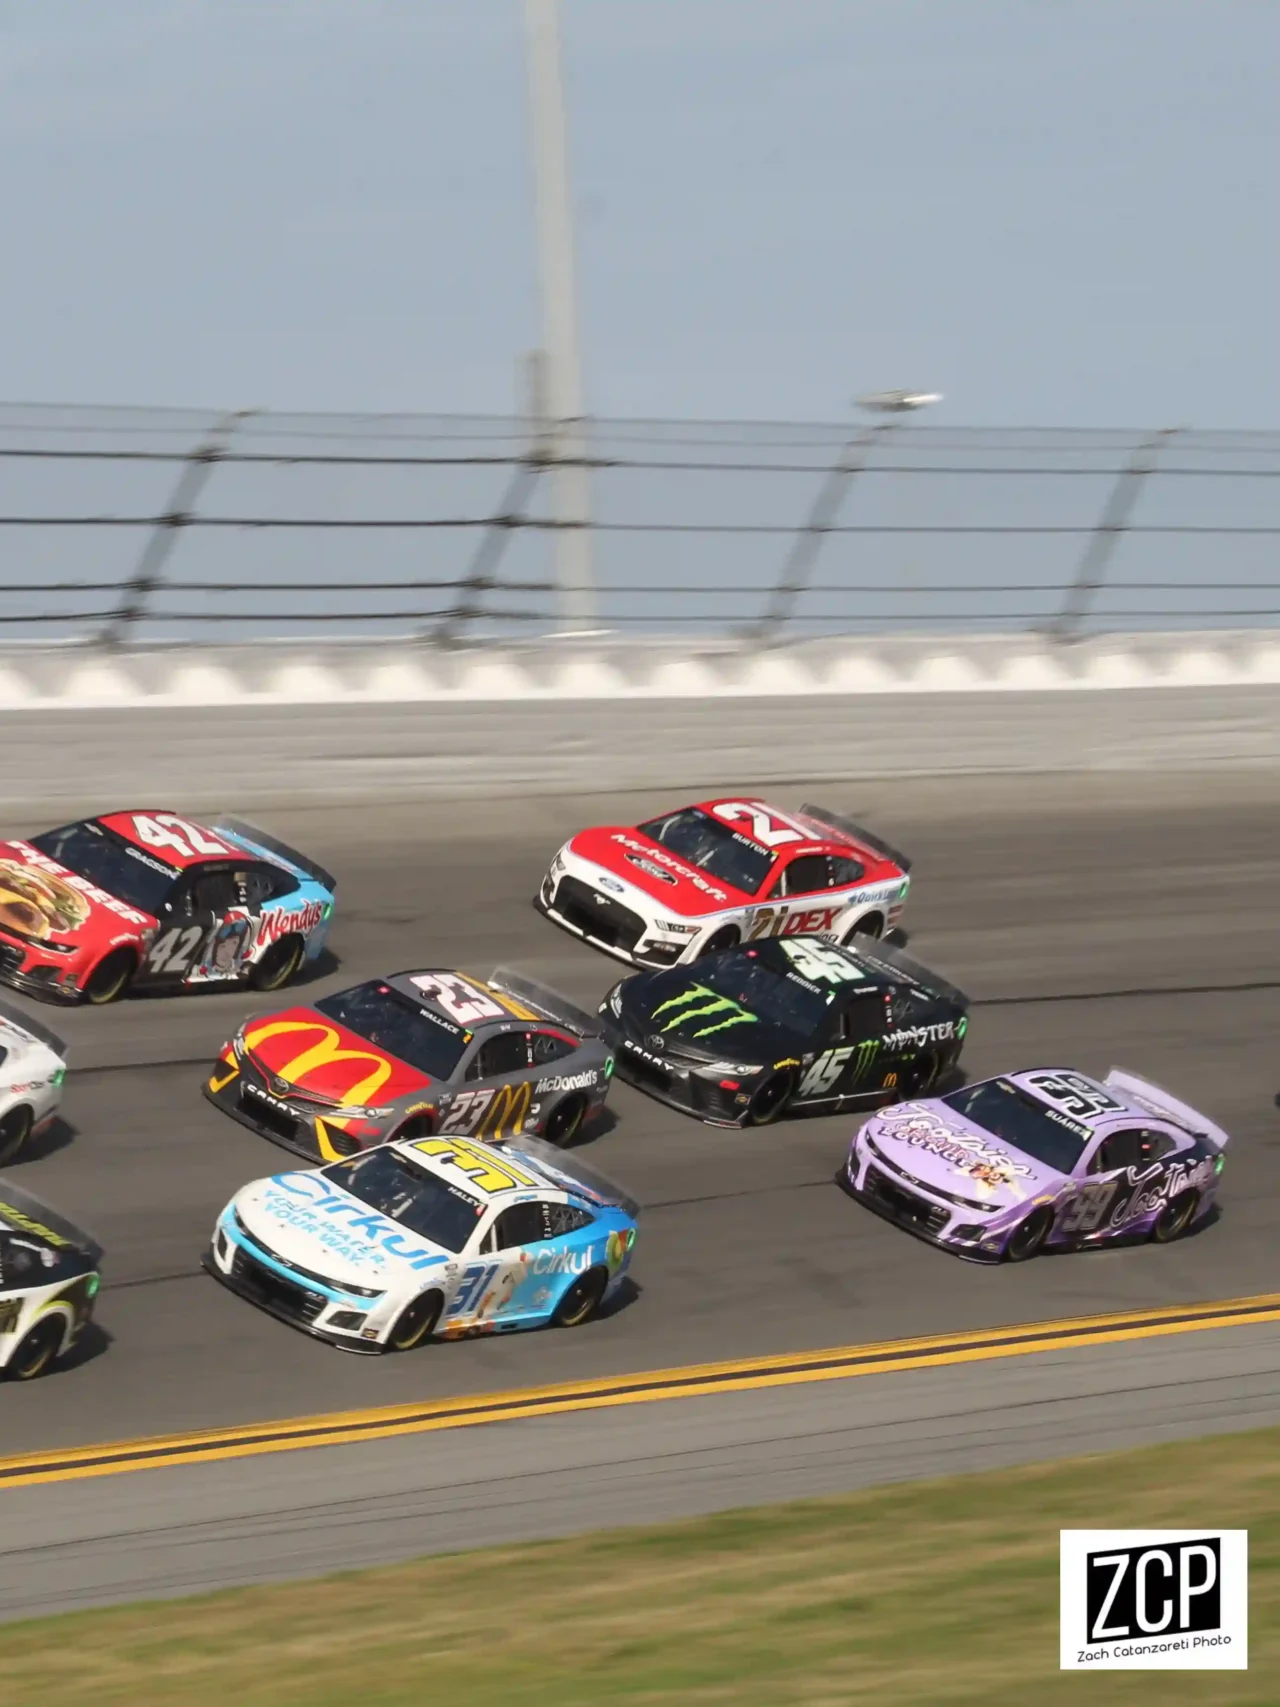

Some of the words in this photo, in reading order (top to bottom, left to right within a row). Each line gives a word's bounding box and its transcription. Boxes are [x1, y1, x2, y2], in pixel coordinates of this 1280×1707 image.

[131, 815, 229, 857] 42
[713, 802, 822, 847] 21
[731, 832, 769, 856] BURTON
[6, 840, 70, 875] THE
[62, 875, 148, 925] BEEF
[610, 833, 727, 902] Motorcraft
[782, 907, 843, 935] DEX
[148, 926, 203, 973] 42
[409, 973, 505, 1025] 23
[785, 971, 822, 995] REDDICK
[419, 1008, 460, 1035] WALLACE
[882, 1021, 955, 1050] MONSTER
[535, 1070, 598, 1095] McDonald's
[798, 1046, 855, 1097] 45
[246, 1084, 300, 1116] CAMRY
[438, 1088, 496, 1136] 23
[409, 1137, 539, 1194] 31
[877, 1127, 973, 1168] LOUNGE
[264, 1189, 318, 1220] YOUR
[447, 1186, 482, 1208] HALEY
[1062, 1181, 1119, 1232] 99
[264, 1202, 319, 1234] YOUR
[271, 1171, 450, 1271] Cirkul
[533, 1245, 593, 1275] Cirkul
[445, 1259, 503, 1317] 31
